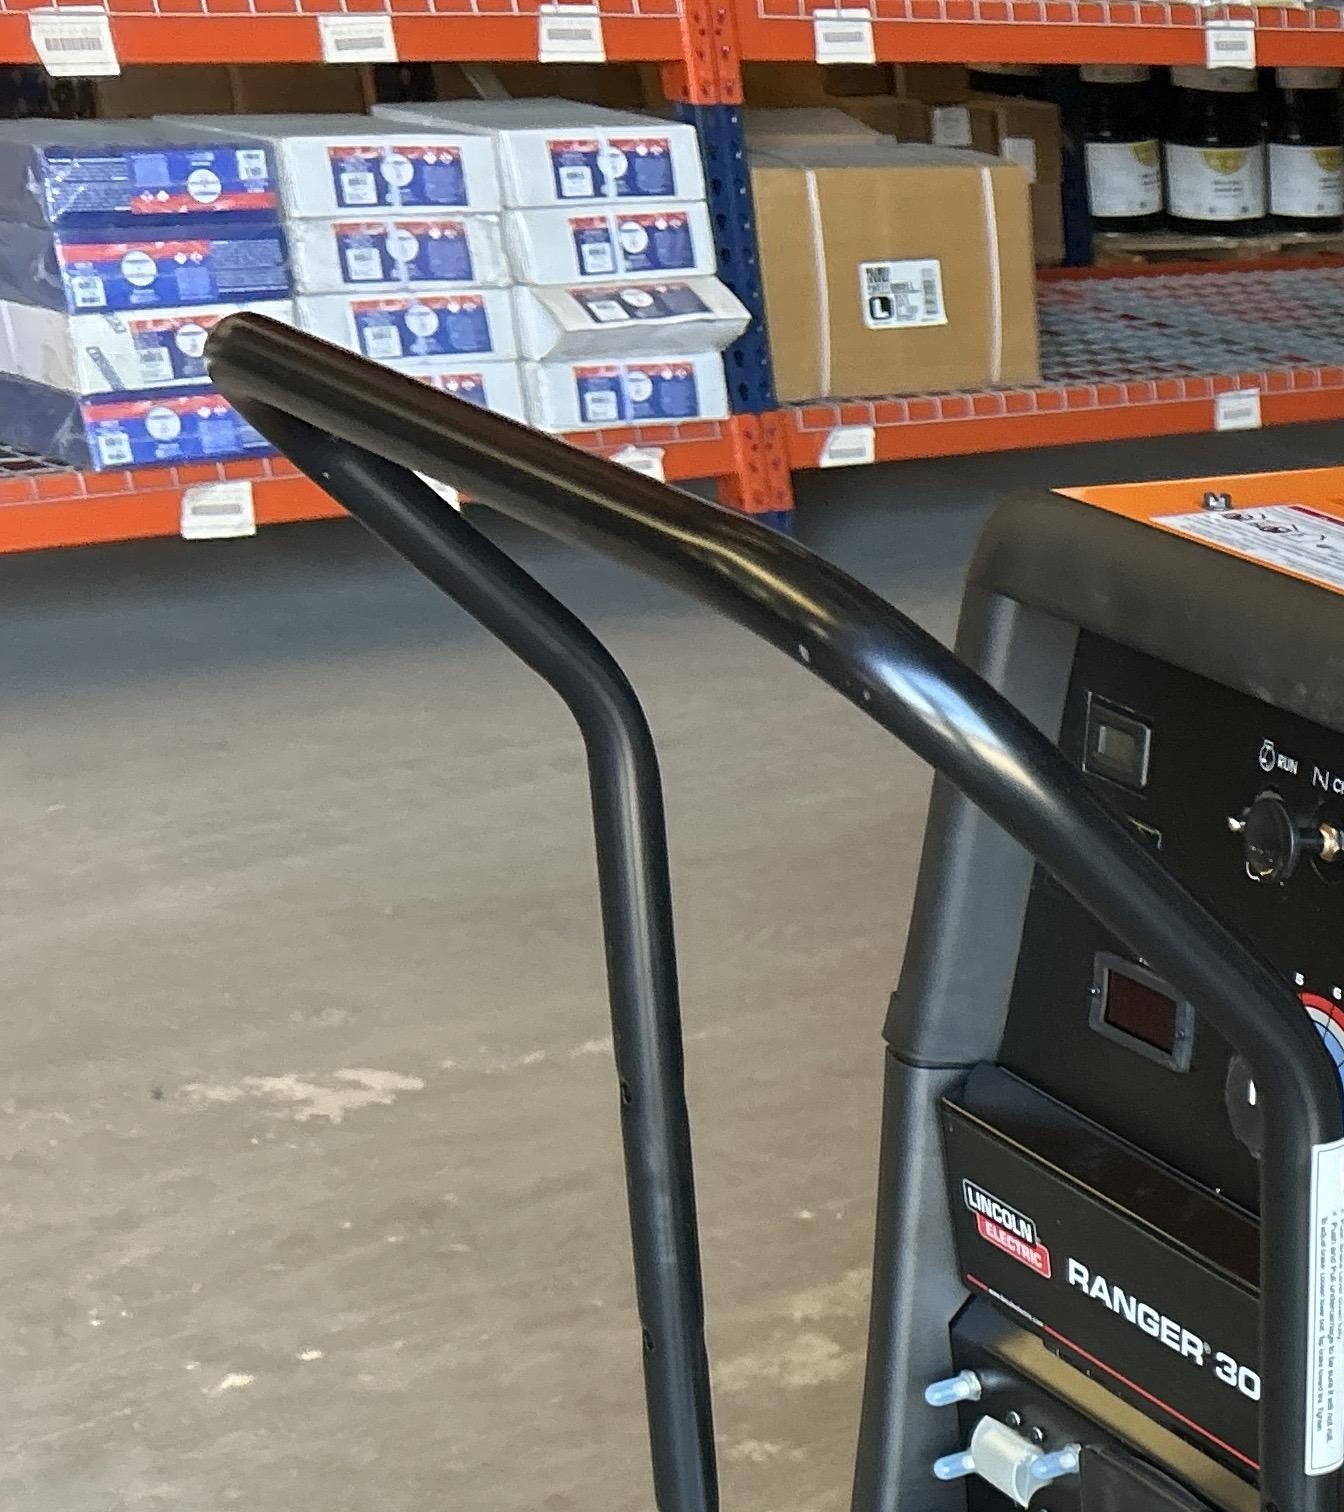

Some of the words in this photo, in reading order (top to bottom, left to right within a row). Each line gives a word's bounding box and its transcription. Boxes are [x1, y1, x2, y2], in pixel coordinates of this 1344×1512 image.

[1277, 753, 1298, 775] RUN
[968, 1186, 1033, 1242] LINCOLN
[984, 1221, 1043, 1270] ELECTRIC
